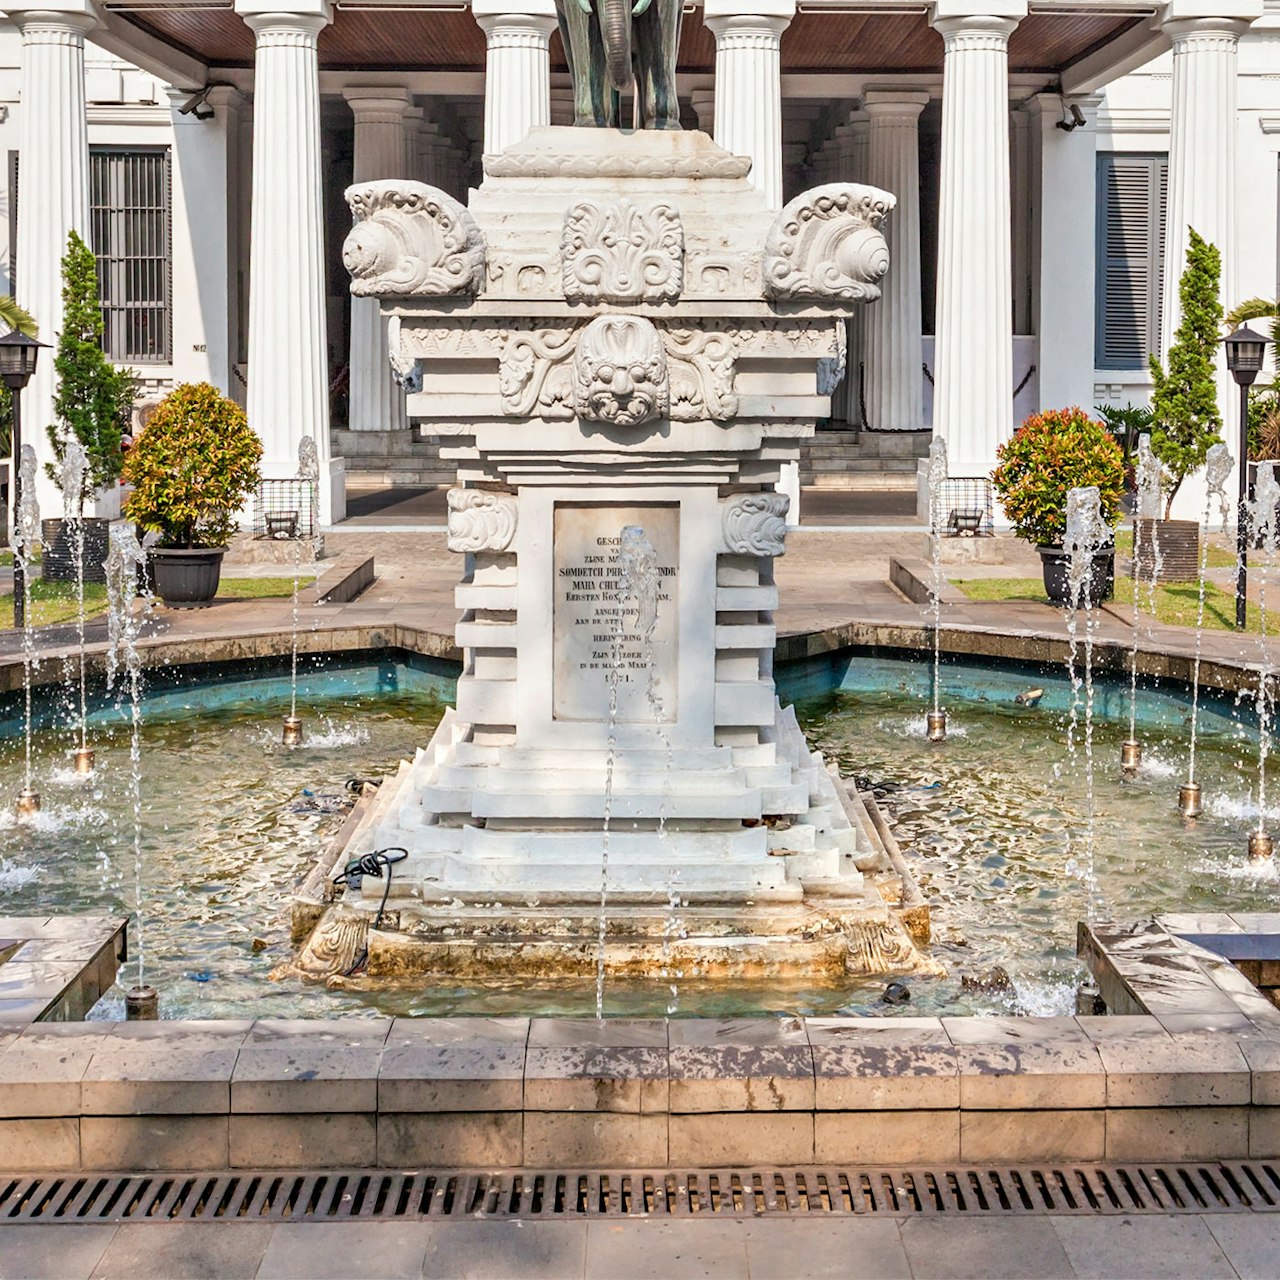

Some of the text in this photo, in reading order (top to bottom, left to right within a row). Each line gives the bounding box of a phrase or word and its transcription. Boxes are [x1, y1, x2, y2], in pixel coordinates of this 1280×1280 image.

[559, 567, 626, 577] SOMDETCH PHR
[572, 581, 596, 590] MAHA
[605, 674, 634, 682] 171.
